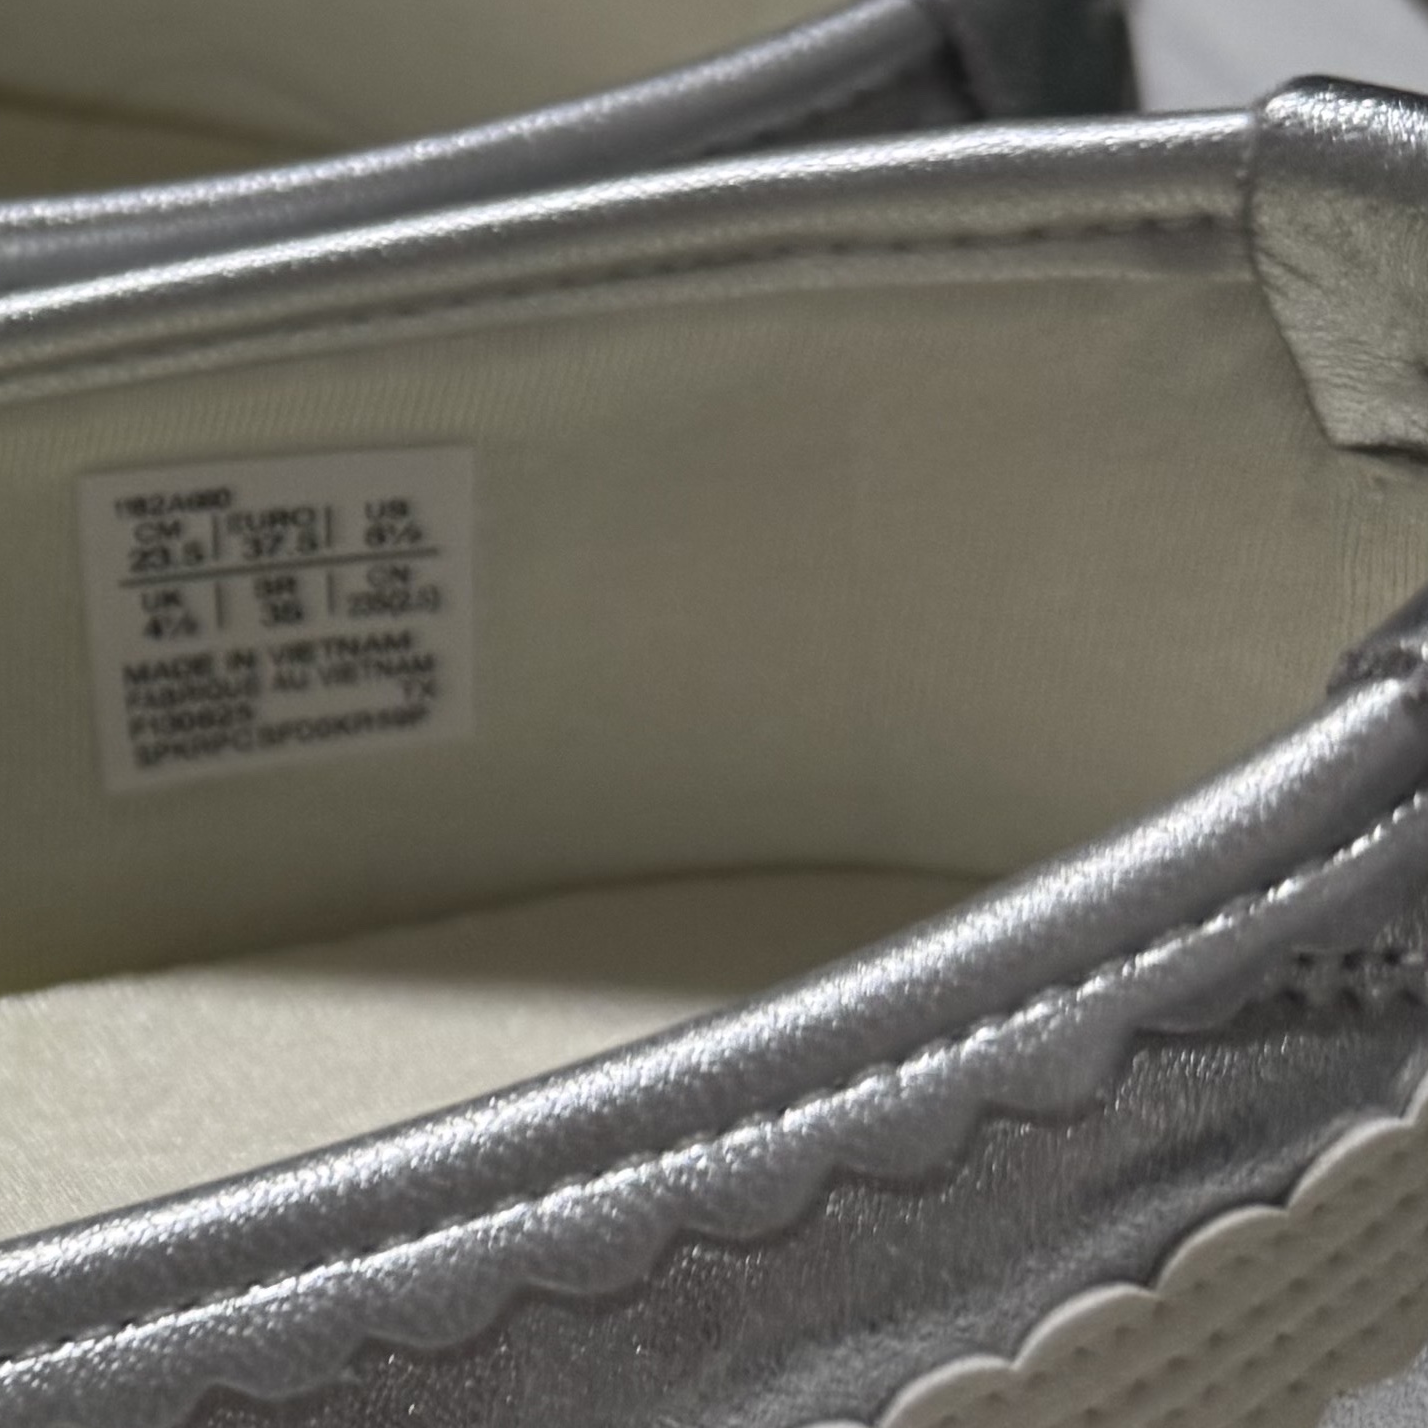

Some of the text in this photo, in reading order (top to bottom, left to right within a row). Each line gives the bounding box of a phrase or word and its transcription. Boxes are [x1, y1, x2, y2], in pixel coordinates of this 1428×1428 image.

[133, 498, 409, 544] CM EURO US
[142, 589, 183, 614] UK
[366, 564, 412, 589] CN
[123, 630, 412, 685] MADE IN VIETNAM
[272, 668, 309, 693] AU
[318, 653, 437, 690] VIETNAM
